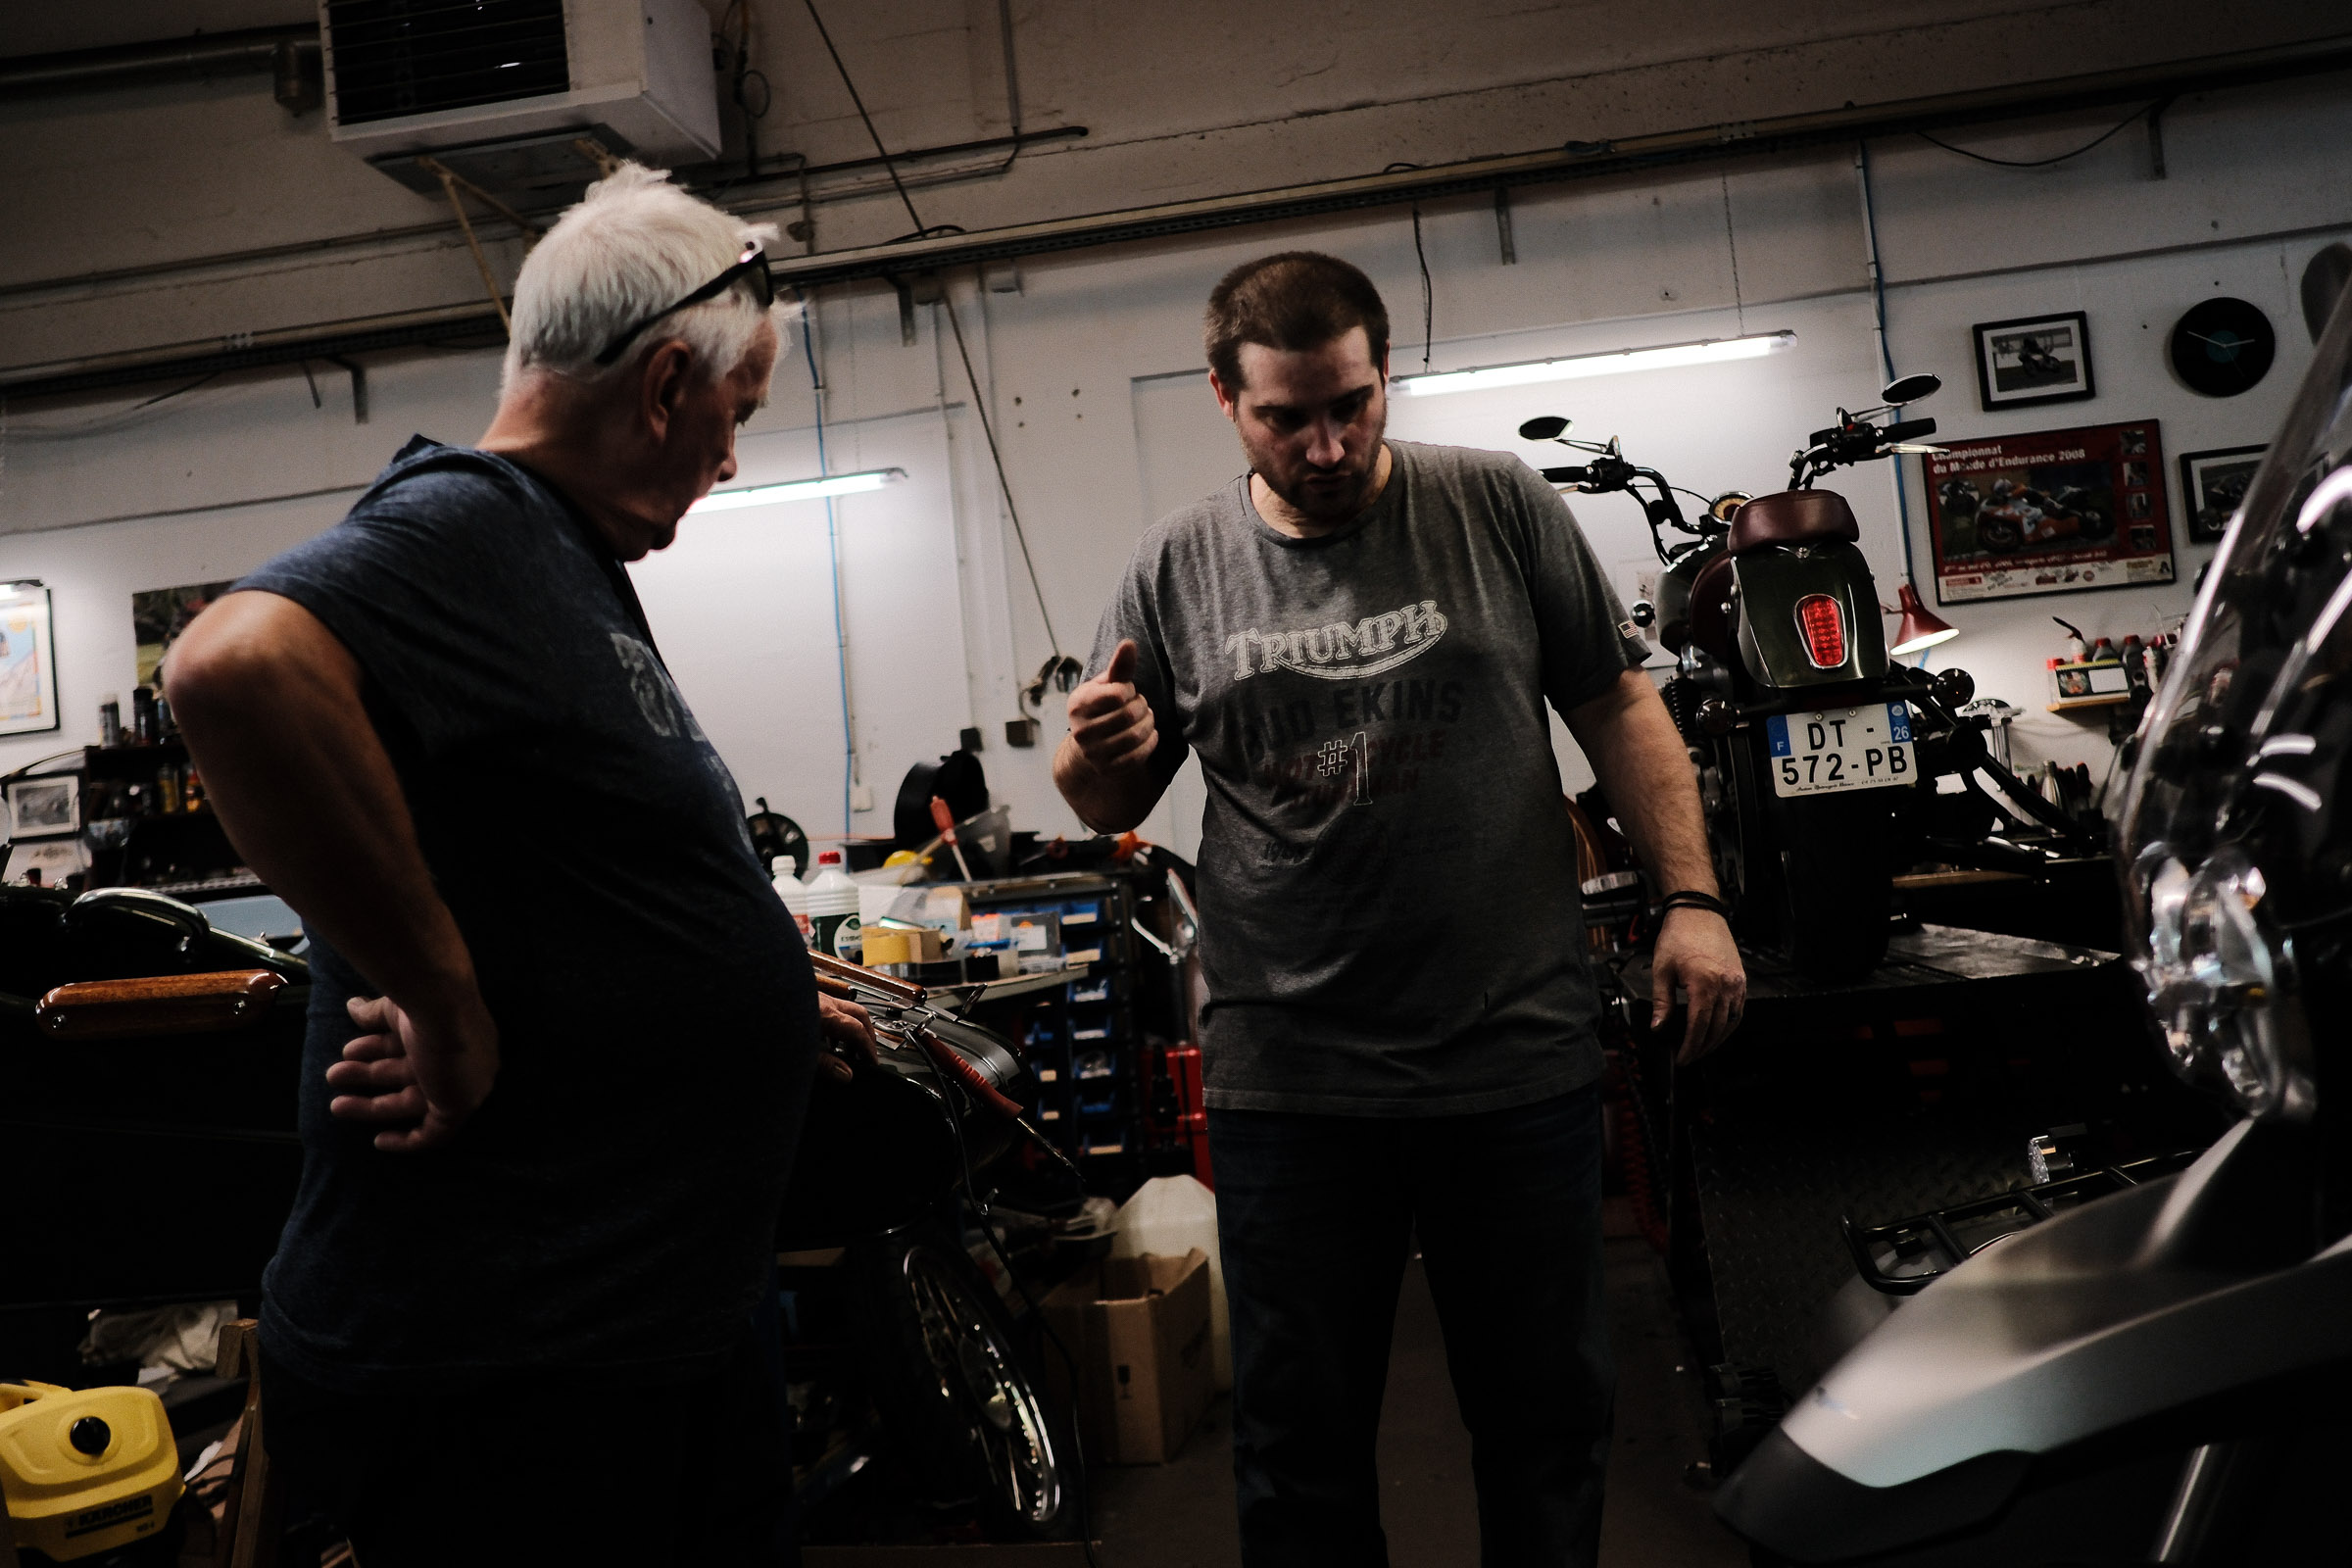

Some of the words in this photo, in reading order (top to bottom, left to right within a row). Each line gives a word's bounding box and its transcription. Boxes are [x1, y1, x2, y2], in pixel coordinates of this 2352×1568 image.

[1933, 462, 1947, 474] du
[1988, 452, 2056, 468] d'Endurance
[2058, 448, 2086, 462] 2008
[1225, 600, 1448, 680] TRIUMPH
[1333, 678, 1465, 729] EKINS
[1776, 741, 1785, 752] F
[1807, 719, 1846, 751] DT
[1893, 725, 1910, 741] 26
[1317, 732, 1373, 806] #1
[1782, 746, 1907, 785] 572-PB
